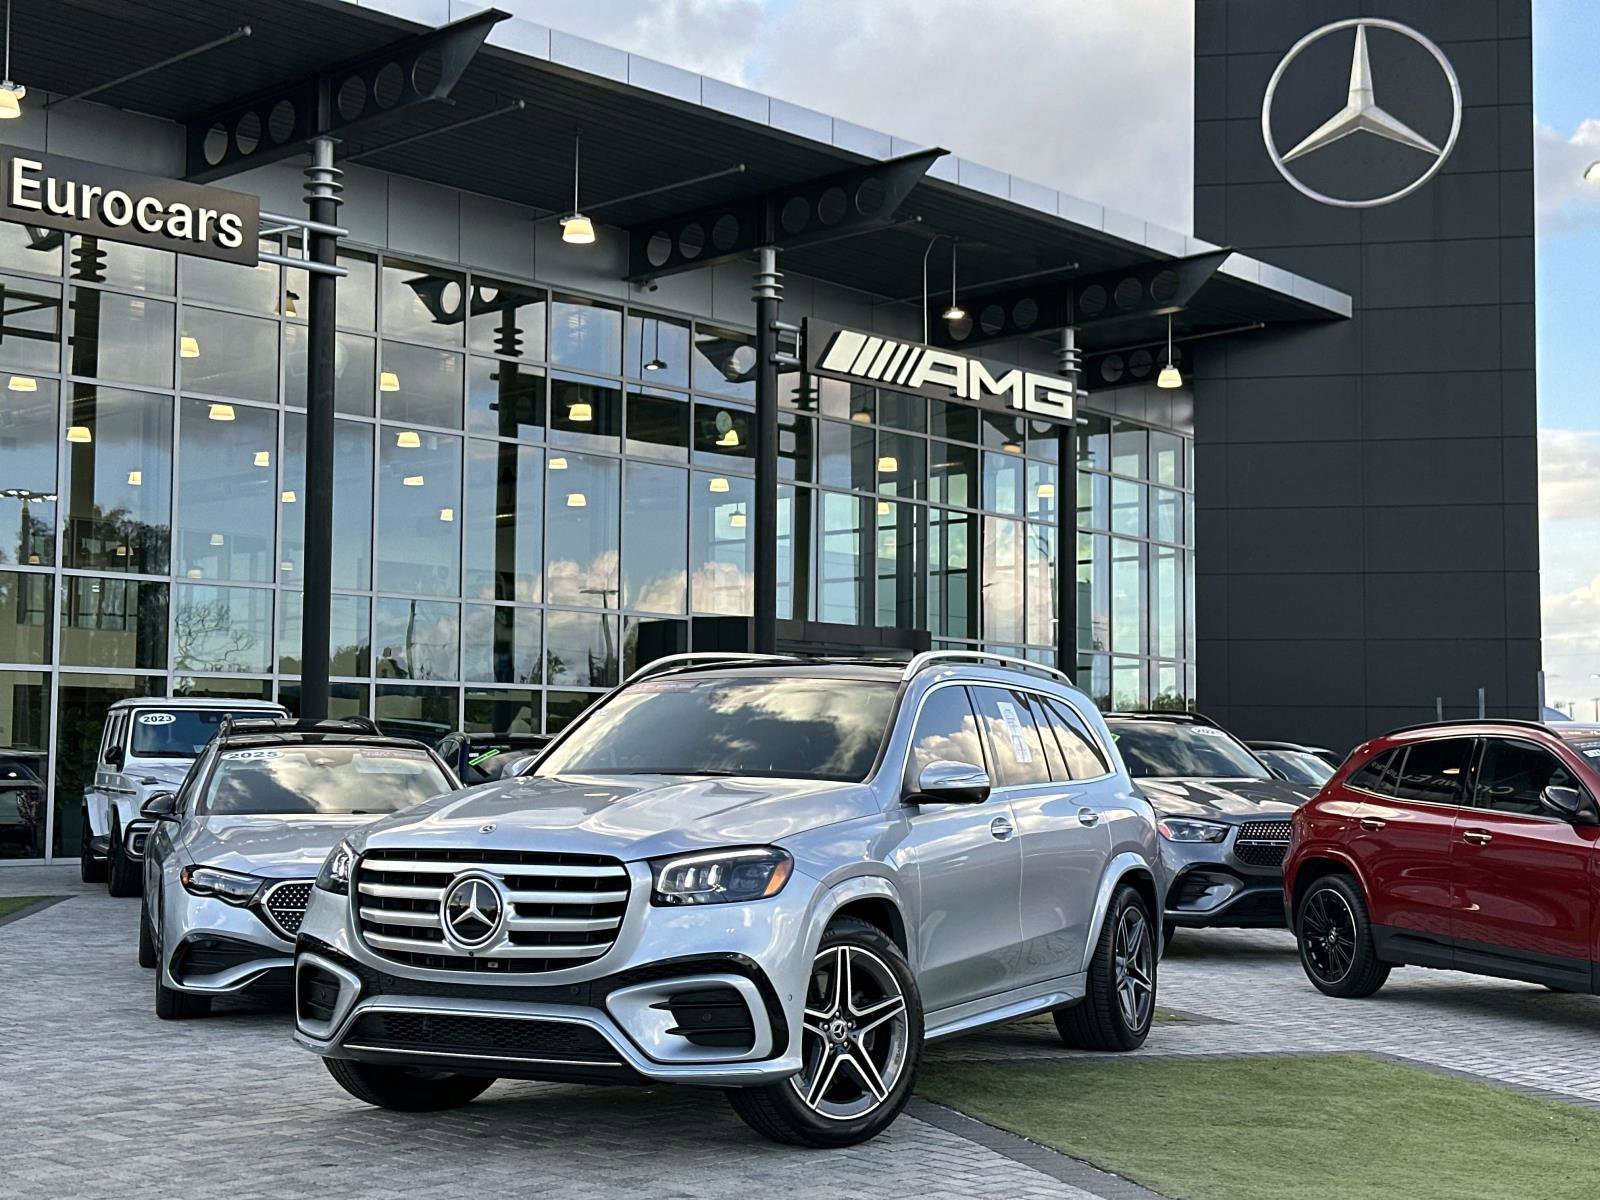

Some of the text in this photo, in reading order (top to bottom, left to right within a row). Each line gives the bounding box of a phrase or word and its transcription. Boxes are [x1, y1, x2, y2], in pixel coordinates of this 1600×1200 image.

[12, 157, 243, 248] Eurocars
[908, 349, 1073, 419] AMG
[143, 715, 172, 723] 2023
[228, 751, 279, 759] 2025
